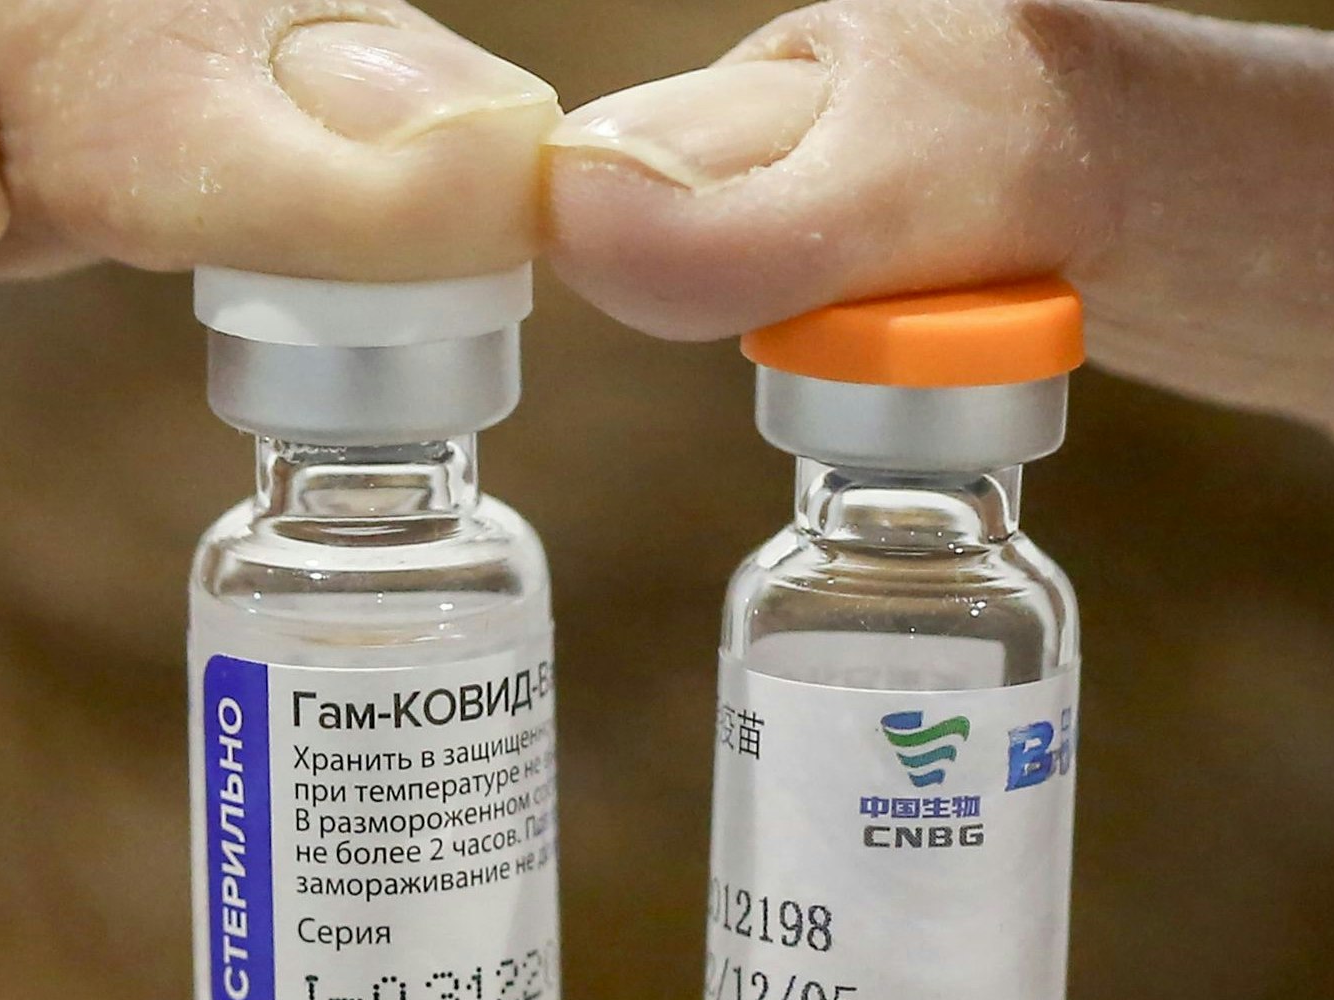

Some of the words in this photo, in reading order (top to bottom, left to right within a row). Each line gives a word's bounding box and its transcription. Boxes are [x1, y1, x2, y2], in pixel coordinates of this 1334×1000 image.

[292, 661, 553, 729] Гам-КОВИД-В
[293, 745, 413, 776] Хранить
[421, 750, 435, 768] в
[294, 783, 347, 807] при
[354, 764, 520, 804] температуре
[296, 808, 310, 831] В
[320, 793, 530, 839] размороженном
[859, 795, 981, 818] 中国生物
[218, 697, 250, 1000] СТЕРИЛЬНО
[296, 845, 327, 864] не
[336, 840, 421, 865] более
[430, 838, 443, 861] 2
[452, 829, 521, 857] часов.
[863, 823, 984, 848] CNBG
[296, 861, 510, 902] замораживание
[297, 918, 392, 950] Серия
